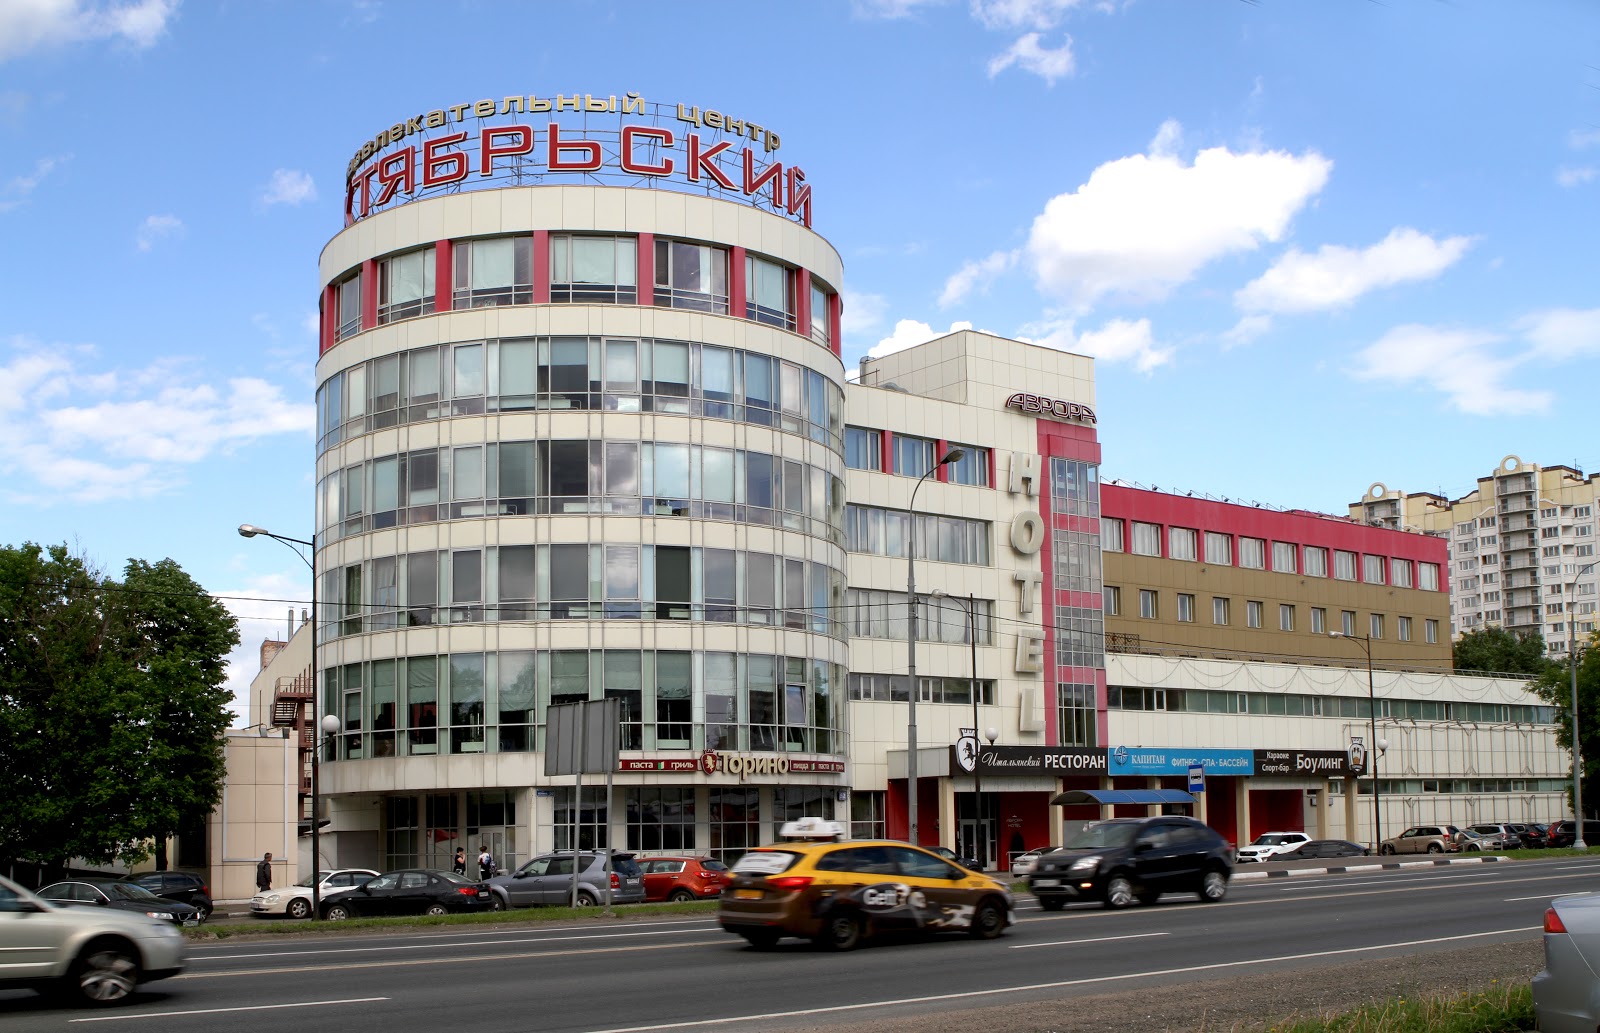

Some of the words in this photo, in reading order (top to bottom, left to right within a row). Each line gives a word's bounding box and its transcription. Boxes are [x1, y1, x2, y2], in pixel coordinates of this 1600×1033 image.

[676, 103, 781, 153] центр
[1005, 393, 1097, 424] АВРОРА
[1009, 451, 1046, 733] HOTEL
[717, 752, 789, 779] Торино
[981, 752, 1041, 767] Итальянский
[1044, 754, 1106, 769] РЕСТОРАН
[1131, 754, 1166, 764] КАПИТАН
[1171, 758, 1198, 767] ФИТНЕС
[1201, 758, 1216, 767] СПА
[1219, 756, 1249, 767] БАССЕЙН
[1266, 751, 1290, 762] Караоке
[1296, 754, 1344, 774] Боулинг
[629, 761, 654, 769] паста
[670, 761, 694, 771] гриль
